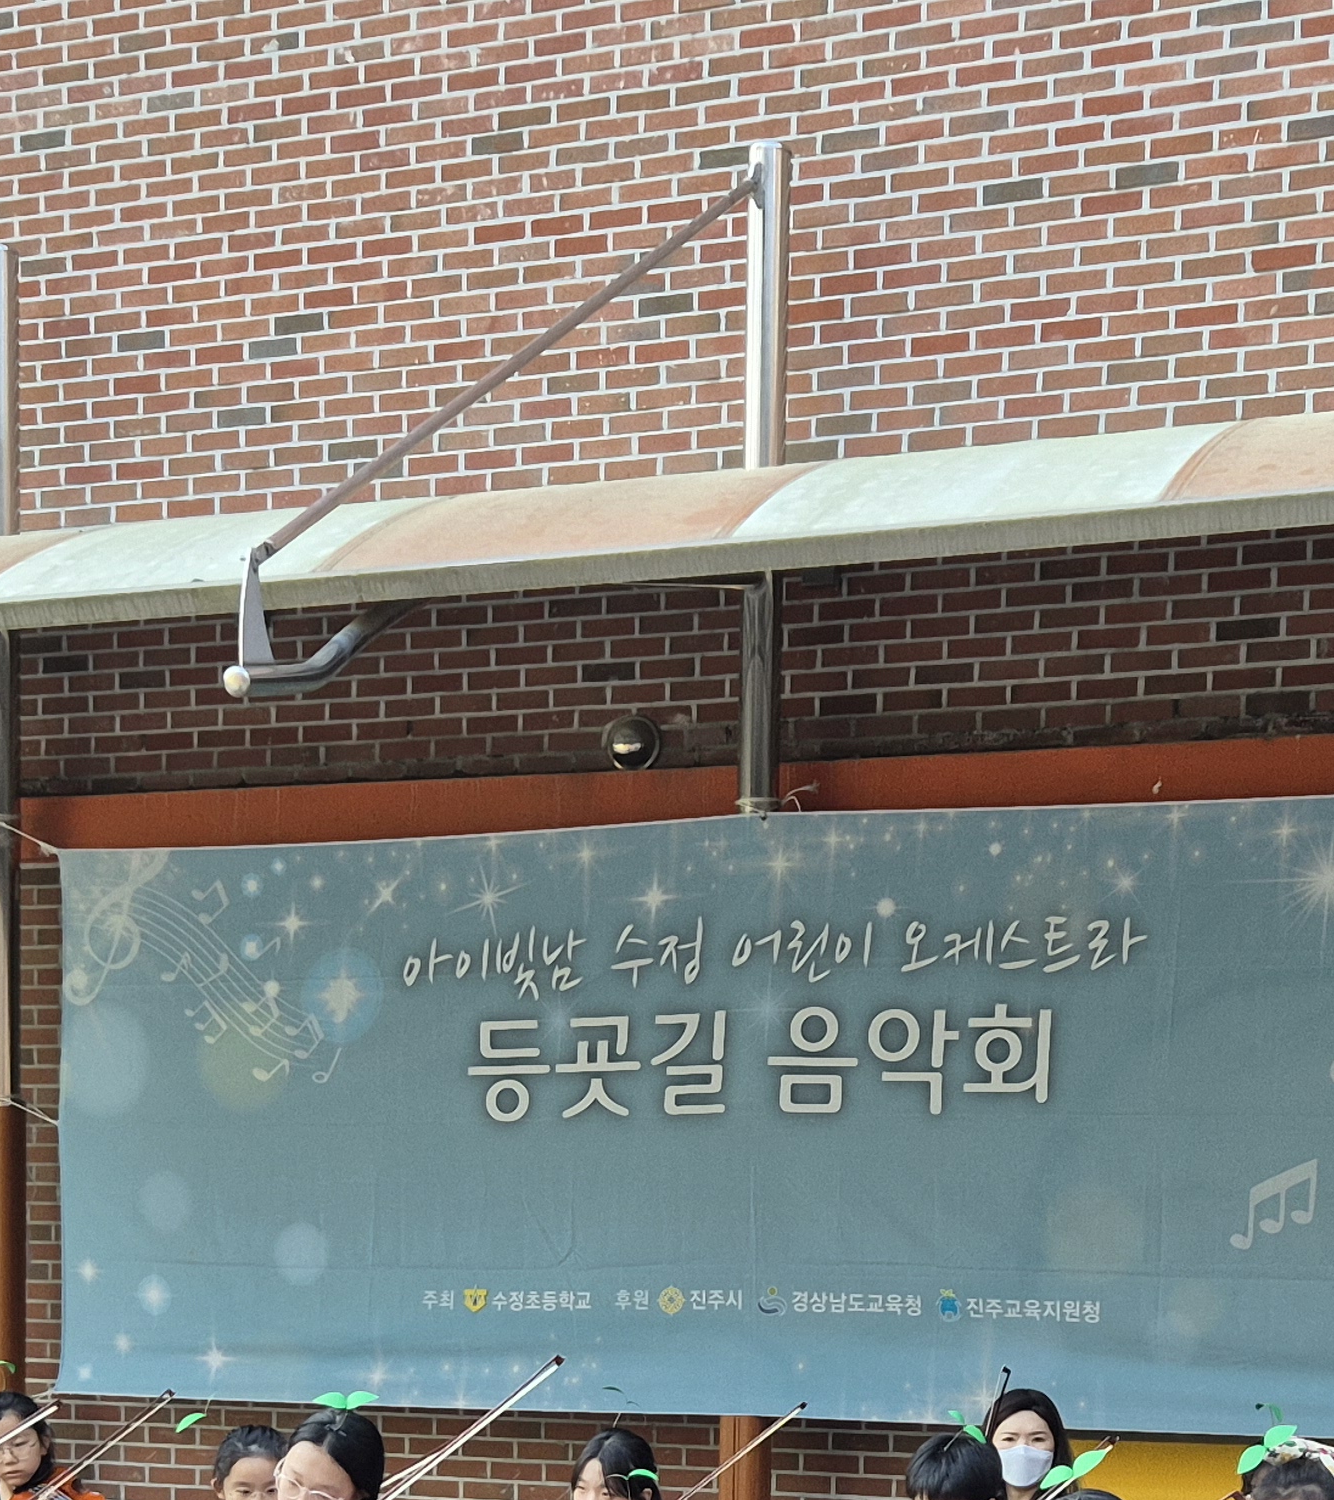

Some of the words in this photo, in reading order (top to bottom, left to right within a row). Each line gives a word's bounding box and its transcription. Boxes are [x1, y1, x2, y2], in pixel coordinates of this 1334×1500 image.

[402, 924, 588, 1001] 아이빛남
[609, 916, 704, 989] 수정
[731, 919, 873, 983] 어린이
[900, 915, 1148, 974] 오케스트라
[467, 1009, 727, 1122] 등굣길
[767, 1003, 1051, 1115] 음악회
[422, 1290, 454, 1311] 주최
[491, 1290, 592, 1312] 수정초등학교
[615, 1290, 650, 1311] 후원
[689, 1289, 744, 1312] 진주시
[791, 1290, 923, 1317] 경상남도교육청
[966, 1297, 1101, 1324] 진주교육지원청
